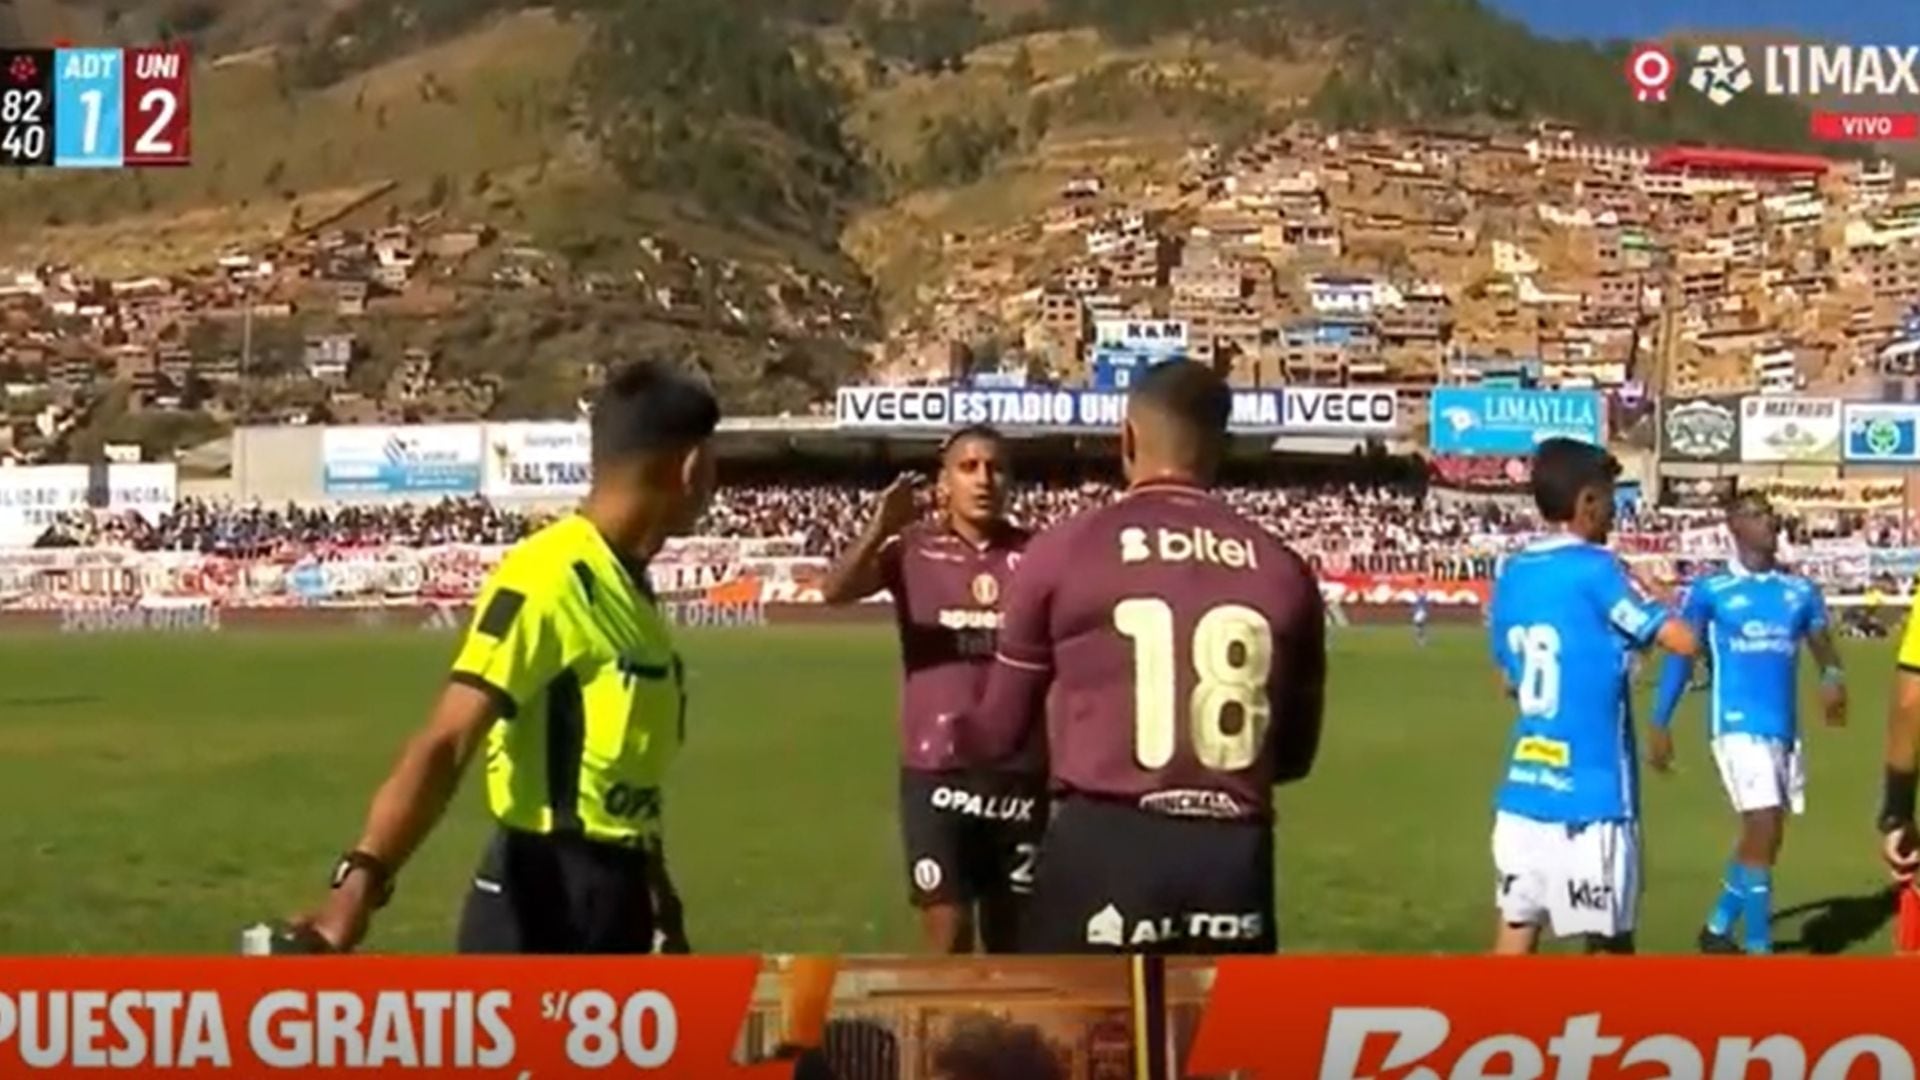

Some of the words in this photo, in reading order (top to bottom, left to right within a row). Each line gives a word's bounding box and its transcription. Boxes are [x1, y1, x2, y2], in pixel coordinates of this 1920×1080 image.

[840, 392, 946, 421] IVECO
[953, 391, 1074, 423] ESTADIO
[1287, 394, 1394, 422] IVECO
[1484, 396, 1595, 424] LIMAYLLA
[1113, 598, 1273, 770] 18
[931, 787, 1035, 820] OPALUX
